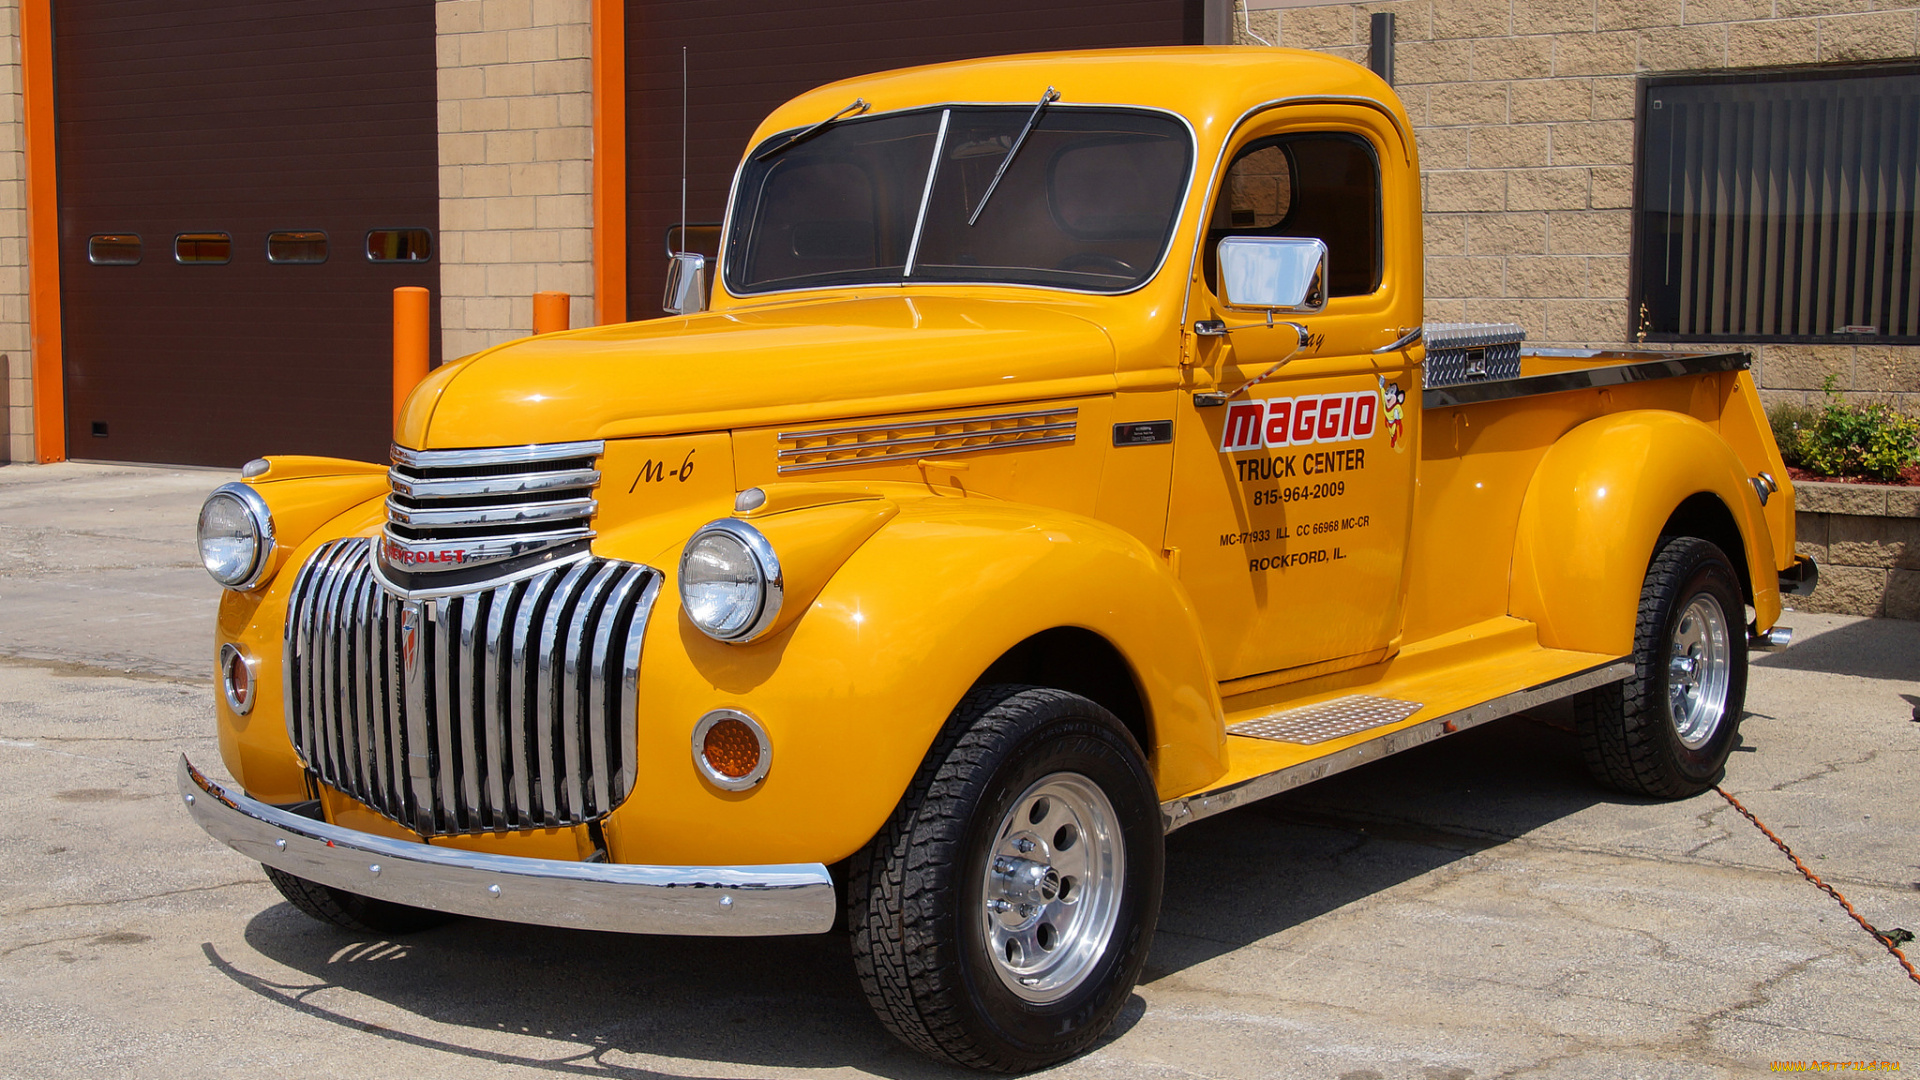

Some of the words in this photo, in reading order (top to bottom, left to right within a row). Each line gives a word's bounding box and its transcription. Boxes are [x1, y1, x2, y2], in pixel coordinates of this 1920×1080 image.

[1236, 455, 1297, 482] TRUCK
[1302, 448, 1365, 476] CENTER
[1253, 481, 1345, 506] 815-964-2009
[1219, 529, 1271, 547] MC-171933
[1275, 526, 1290, 540] ILL
[1296, 524, 1310, 537] CC
[1312, 520, 1339, 535] 66968
[1341, 515, 1370, 531] MC-CR
[1248, 549, 1329, 573] ROCKFORD,
[1332, 547, 1347, 560] IL.
